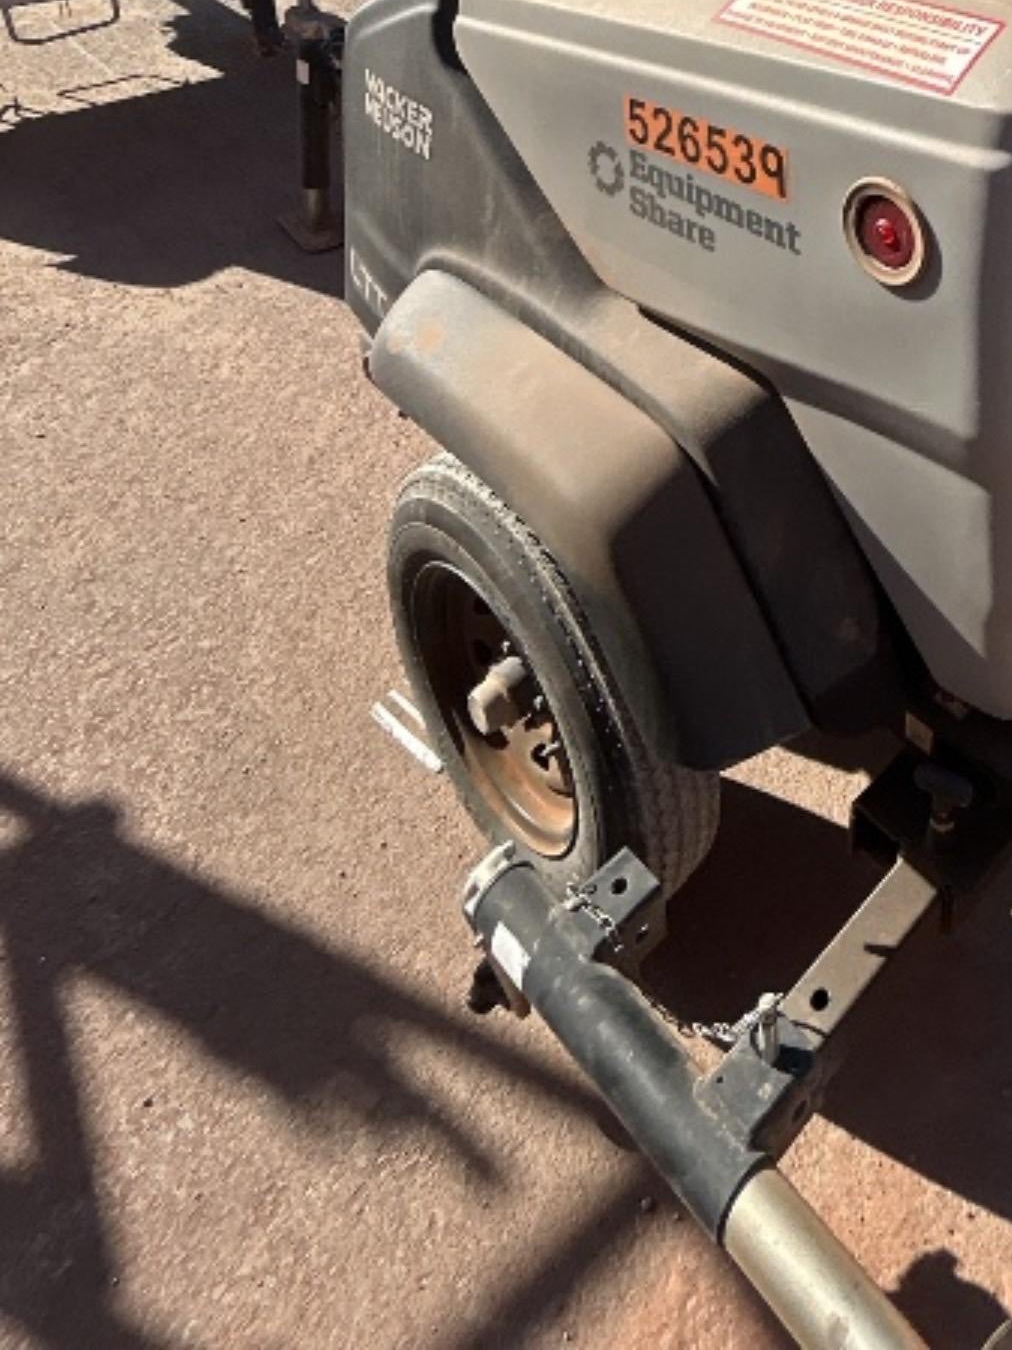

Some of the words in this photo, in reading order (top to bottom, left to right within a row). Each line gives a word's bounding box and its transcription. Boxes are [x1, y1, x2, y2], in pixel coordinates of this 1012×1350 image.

[364, 68, 433, 132] WACKER
[364, 91, 434, 161] NEUSON
[628, 97, 789, 199] 526539
[628, 149, 803, 256] Equipment
[628, 186, 717, 252] Share
